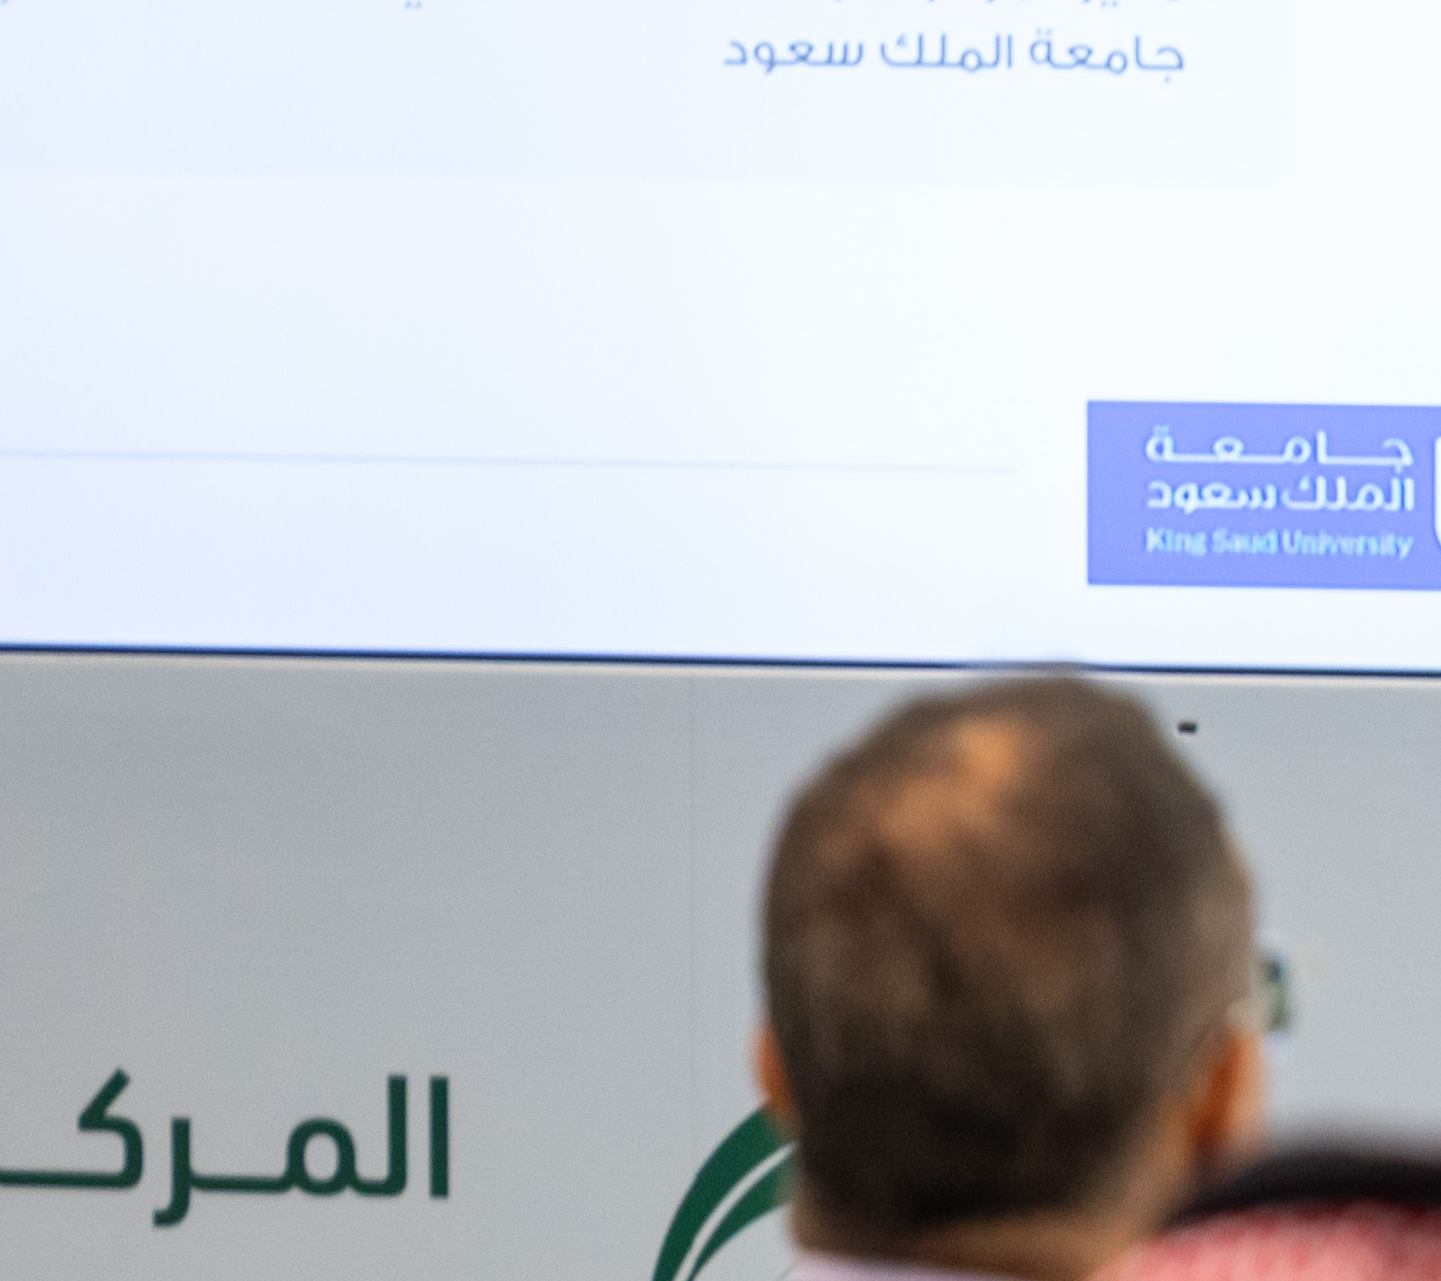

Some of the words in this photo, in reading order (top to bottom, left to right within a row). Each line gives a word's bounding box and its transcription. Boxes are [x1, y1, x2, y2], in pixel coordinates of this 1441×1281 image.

[724, 40, 864, 75] سعود
[879, 33, 1013, 73] الملك
[1028, 29, 1186, 83] جامعة
[1145, 425, 1414, 473] جامعة
[1147, 480, 1277, 515] سعود
[1282, 476, 1416, 512] الملك
[1145, 526, 1207, 557] King
[1212, 527, 1279, 555] Saud
[1283, 528, 1414, 560] University
[0, 1068, 450, 1228] المرك
